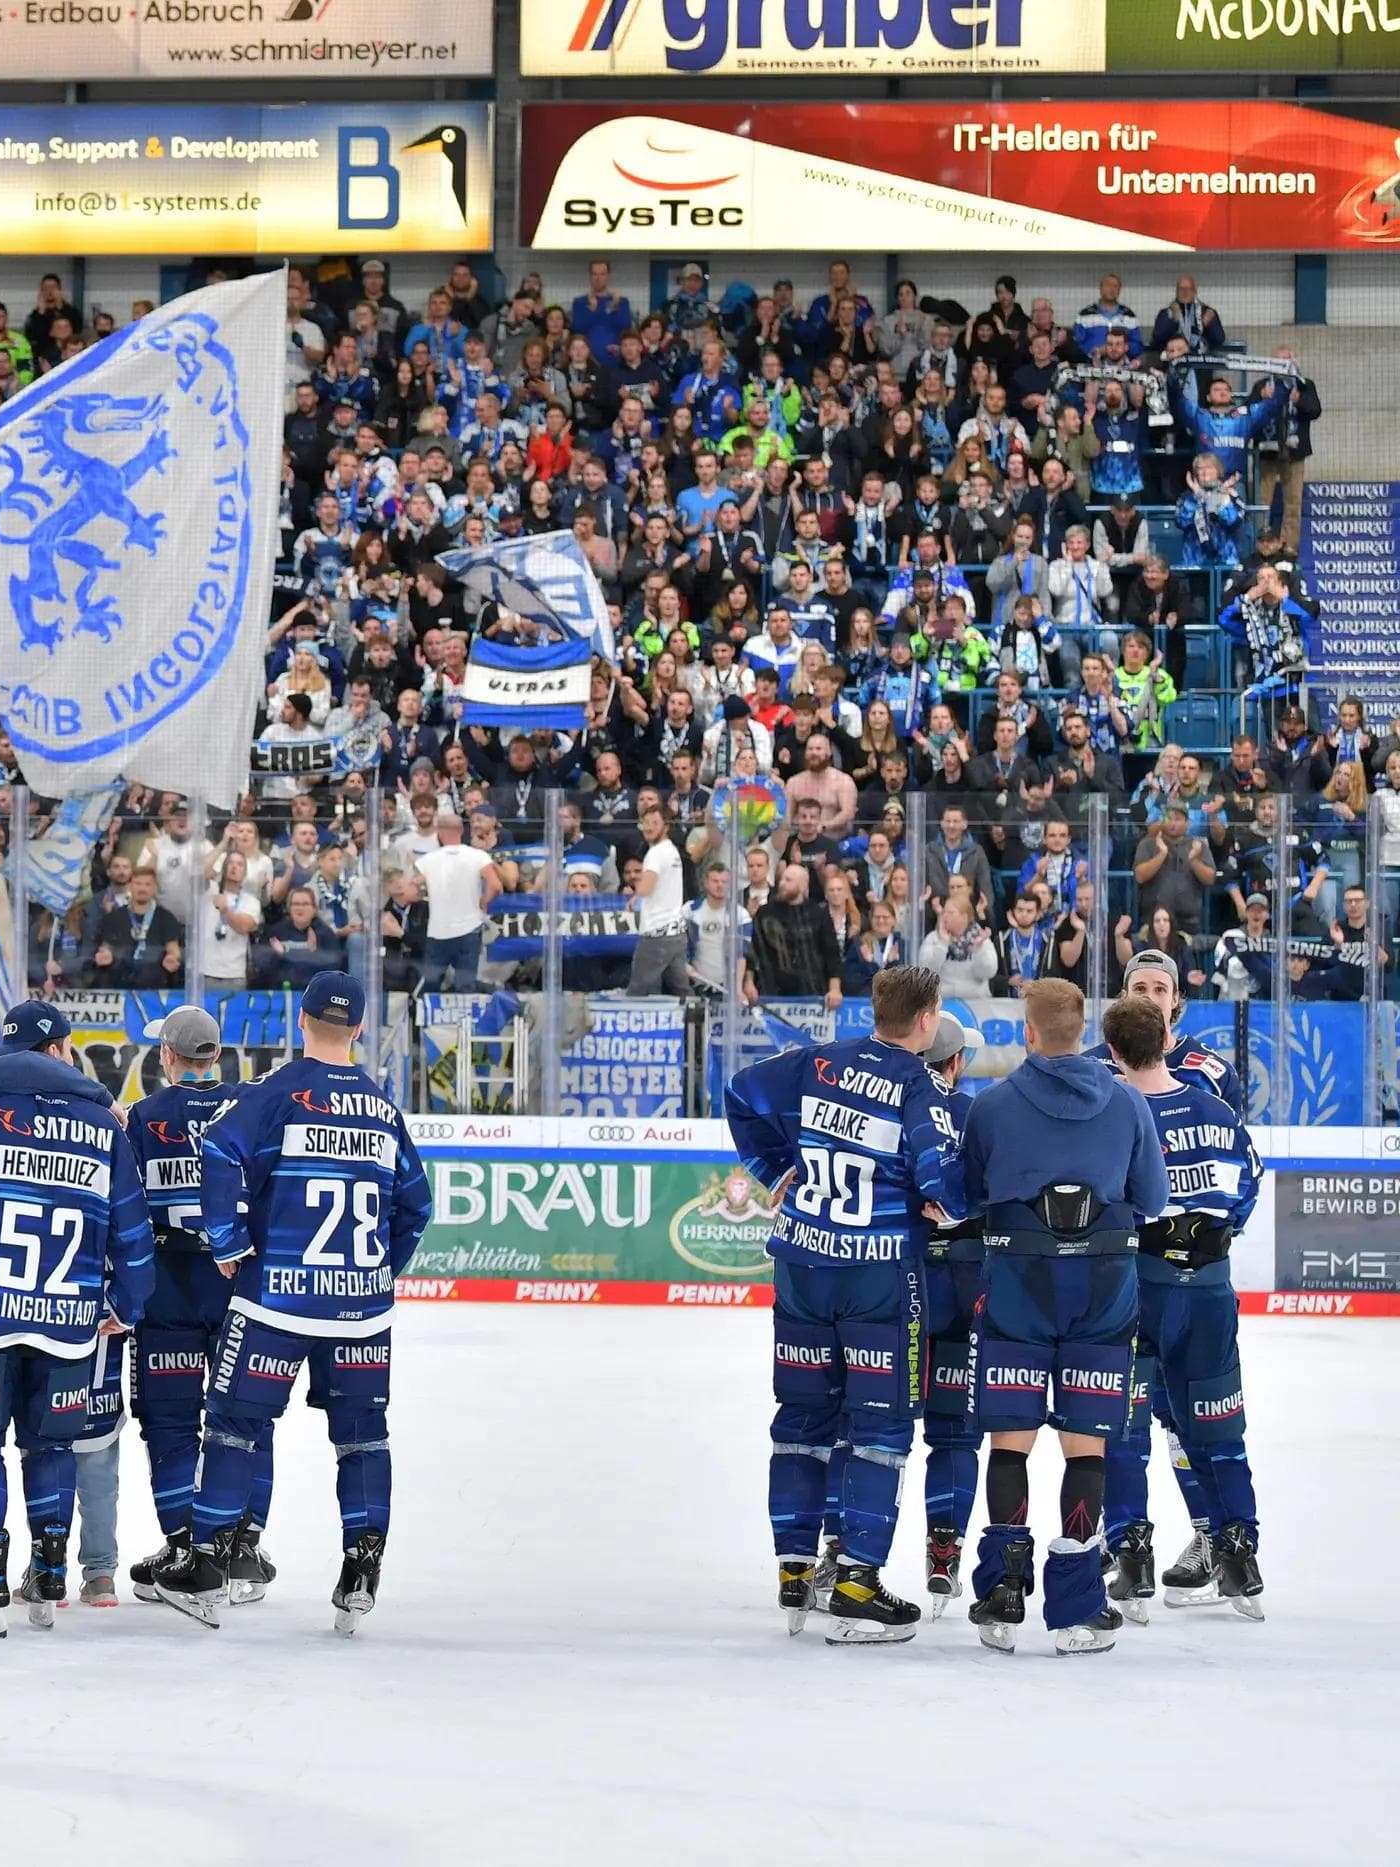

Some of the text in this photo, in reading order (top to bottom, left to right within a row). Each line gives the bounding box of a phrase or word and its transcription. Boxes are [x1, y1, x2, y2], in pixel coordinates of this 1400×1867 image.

[25, 0, 121, 24] Erdbau
[143, 0, 263, 23] Abbruch
[1176, 0, 1400, 41] McDONAL
[902, 57, 1041, 69] Gaimersheim
[48, 138, 138, 163] Support
[145, 137, 163, 158] &
[171, 136, 318, 162] Development
[953, 122, 1157, 152] IT-Helden für
[1098, 165, 1315, 194] Unternehmen
[563, 200, 744, 232] SysTec
[487, 678, 567, 692] ULTRAS
[561, 1066, 683, 1095] MEISTER
[838, 1066, 904, 1108] SATURN
[329, 1091, 397, 1127] SATURN
[811, 1101, 870, 1141] FLAAKE
[32, 1114, 113, 1153] SATURN
[304, 1127, 386, 1160] SORAMIES
[463, 1124, 512, 1139] Audi
[644, 1128, 693, 1142] Audi
[1164, 1125, 1236, 1154] SATURN
[2, 1151, 99, 1187] HENRIQUEZ
[425, 1161, 652, 1232] BRÄU
[1302, 1177, 1363, 1194] BRING
[1303, 1198, 1377, 1214] BEWIRB
[302, 1178, 386, 1268] 28
[793, 1216, 904, 1261] INGOLSTADT
[406, 1240, 542, 1276] pezialitäten
[1302, 1251, 1386, 1278] FMS
[268, 1264, 394, 1298] ERC INGOLSTADT
[1302, 1280, 1339, 1289] FUTURE
[0, 1291, 97, 1327] INGOLSTADT
[148, 1352, 204, 1371] CINQUE
[214, 1313, 247, 1394] SATURN
[334, 1346, 389, 1364] CINQUE
[775, 1342, 832, 1365] CINQUE
[986, 1367, 1046, 1387] CINQUE
[1061, 1368, 1123, 1392] CINQUE
[1194, 1388, 1243, 1418] CINQUE
